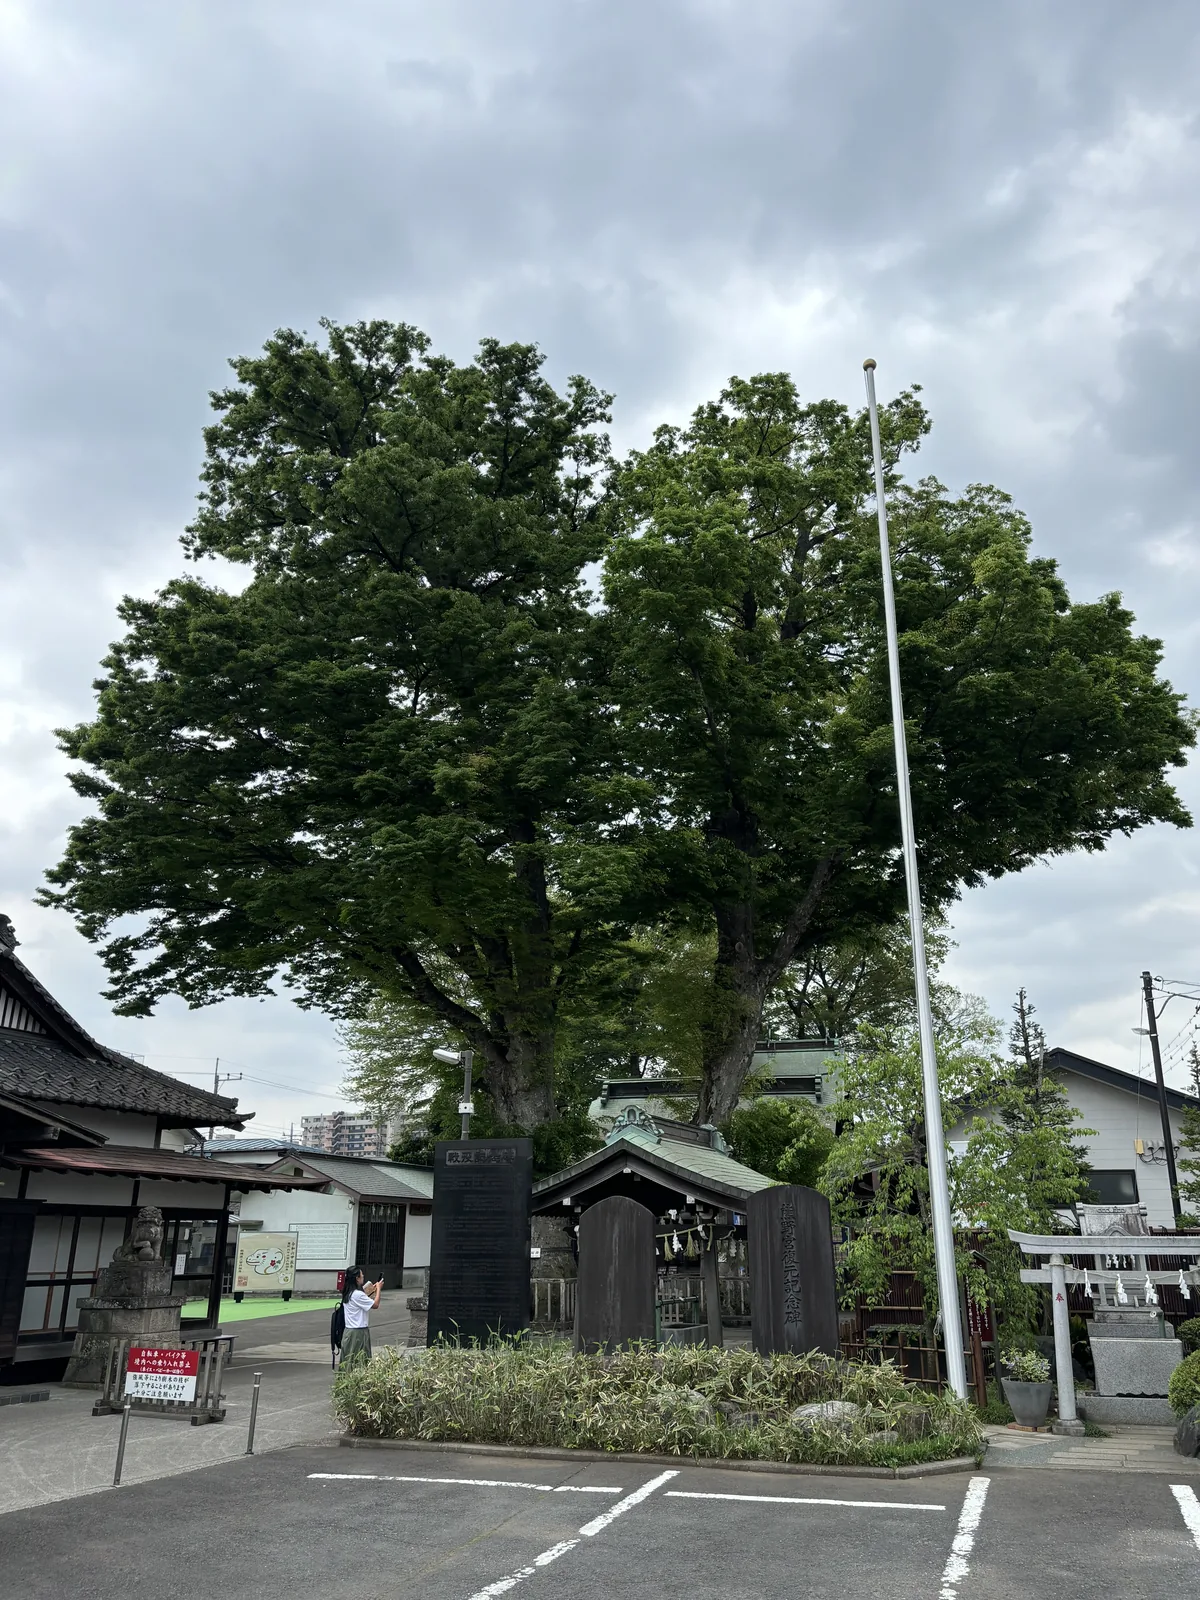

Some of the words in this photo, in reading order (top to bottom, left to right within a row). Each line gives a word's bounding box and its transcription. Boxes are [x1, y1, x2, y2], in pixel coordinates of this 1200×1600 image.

[780, 1203, 802, 1328] 熊野宮復元記念碑
[141, 1350, 187, 1359] 自転車・バイク等
[134, 1358, 191, 1368] 境内への乗り入れ禁止
[133, 1374, 189, 1383] 強風等により樹木の枝が
[134, 1382, 185, 1390] 落下することがあります
